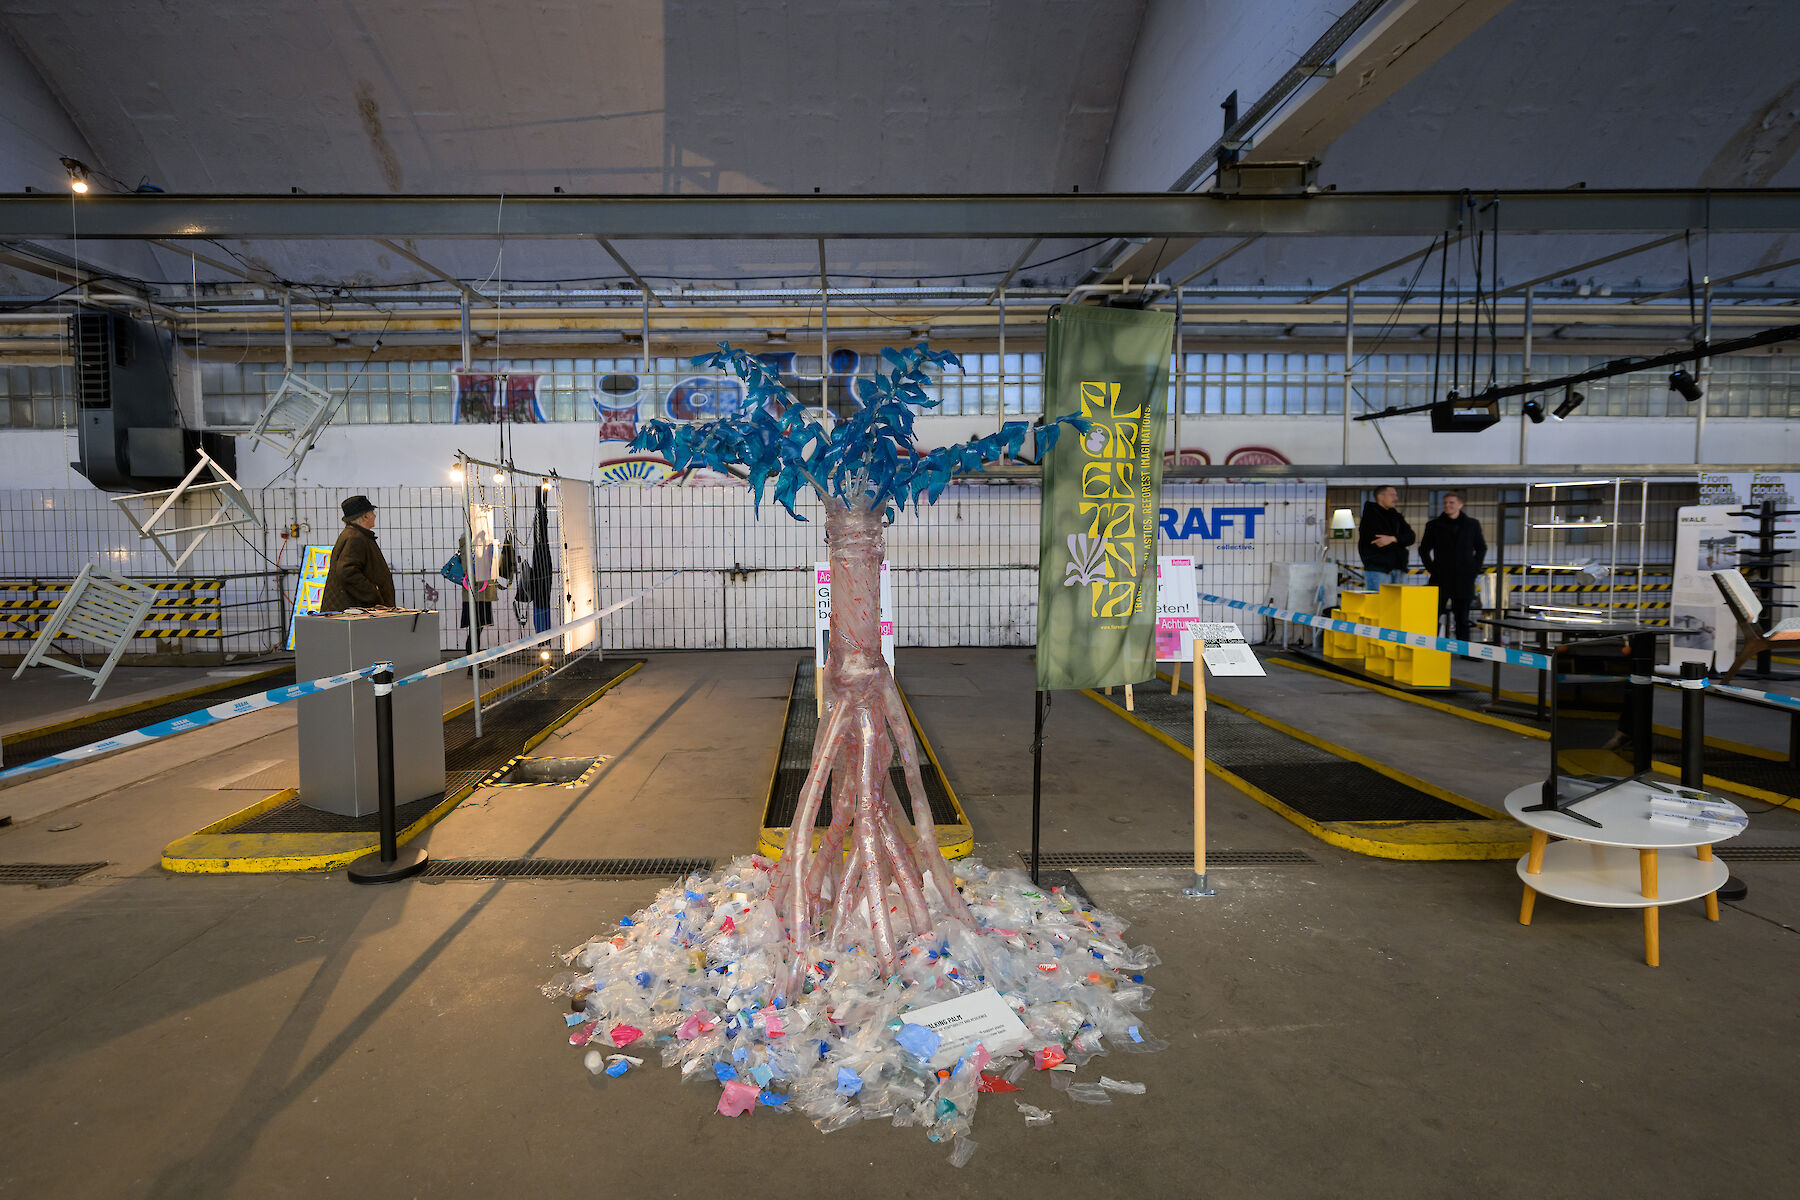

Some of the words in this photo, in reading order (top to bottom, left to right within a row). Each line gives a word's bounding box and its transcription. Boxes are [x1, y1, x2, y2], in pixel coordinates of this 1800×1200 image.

[1140, 404, 1152, 469] IMAGINATIONS.
[1700, 473, 1729, 482] From
[1753, 473, 1782, 482] From
[1141, 471, 1152, 514] REFOREST
[1699, 496, 1711, 505] to
[1158, 507, 1265, 540] RAFT
[947, 1014, 963, 1024] PALM
